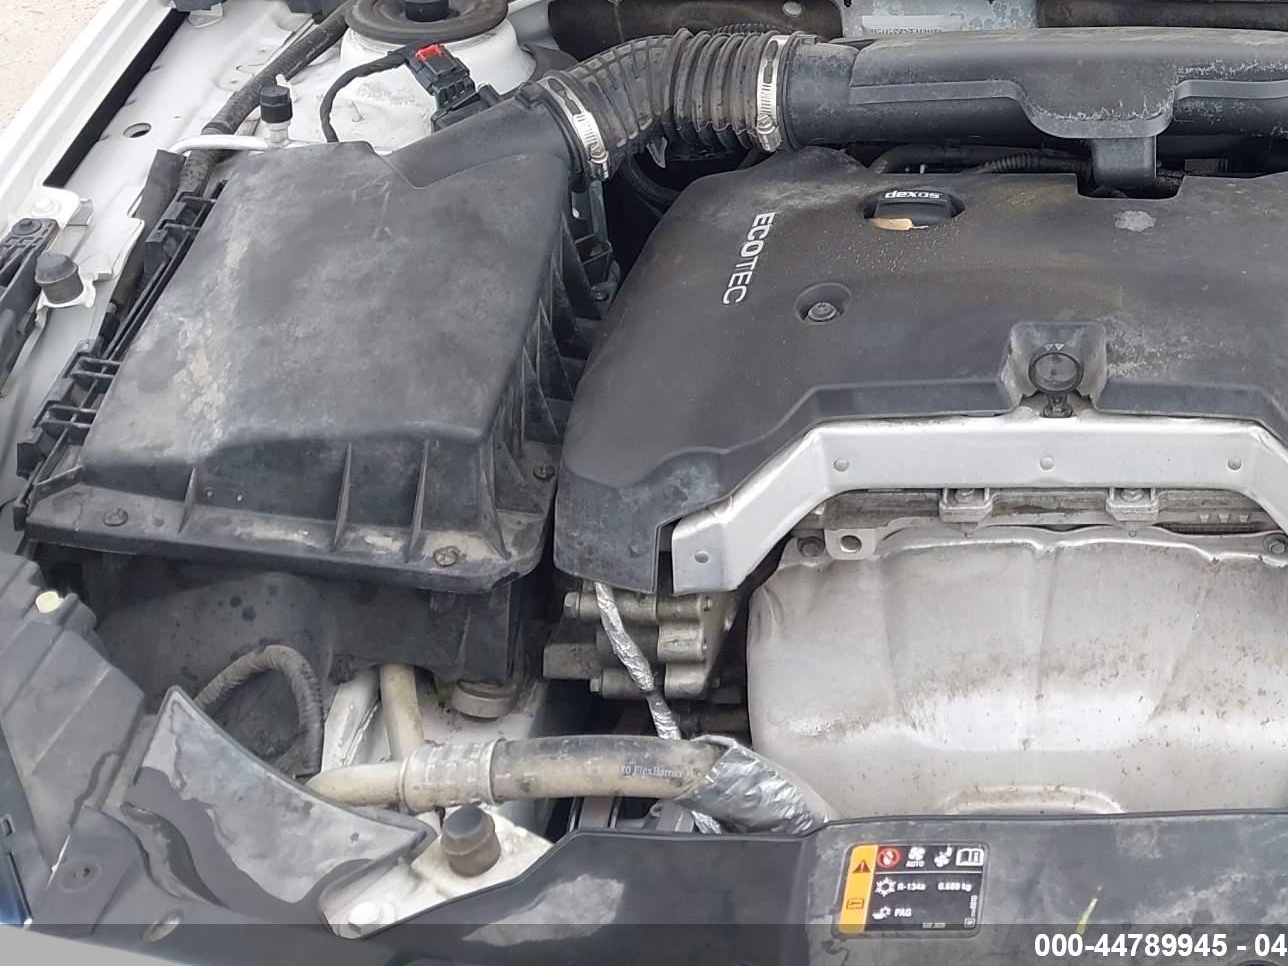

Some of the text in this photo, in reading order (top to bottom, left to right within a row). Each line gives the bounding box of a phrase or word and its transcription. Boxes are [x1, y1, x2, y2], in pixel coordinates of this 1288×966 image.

[884, 189, 942, 199] dexos
[722, 211, 776, 306] ECOTEC
[905, 860, 925, 868] AUTO
[961, 881, 973, 893] kg
[894, 907, 912, 917] PAG
